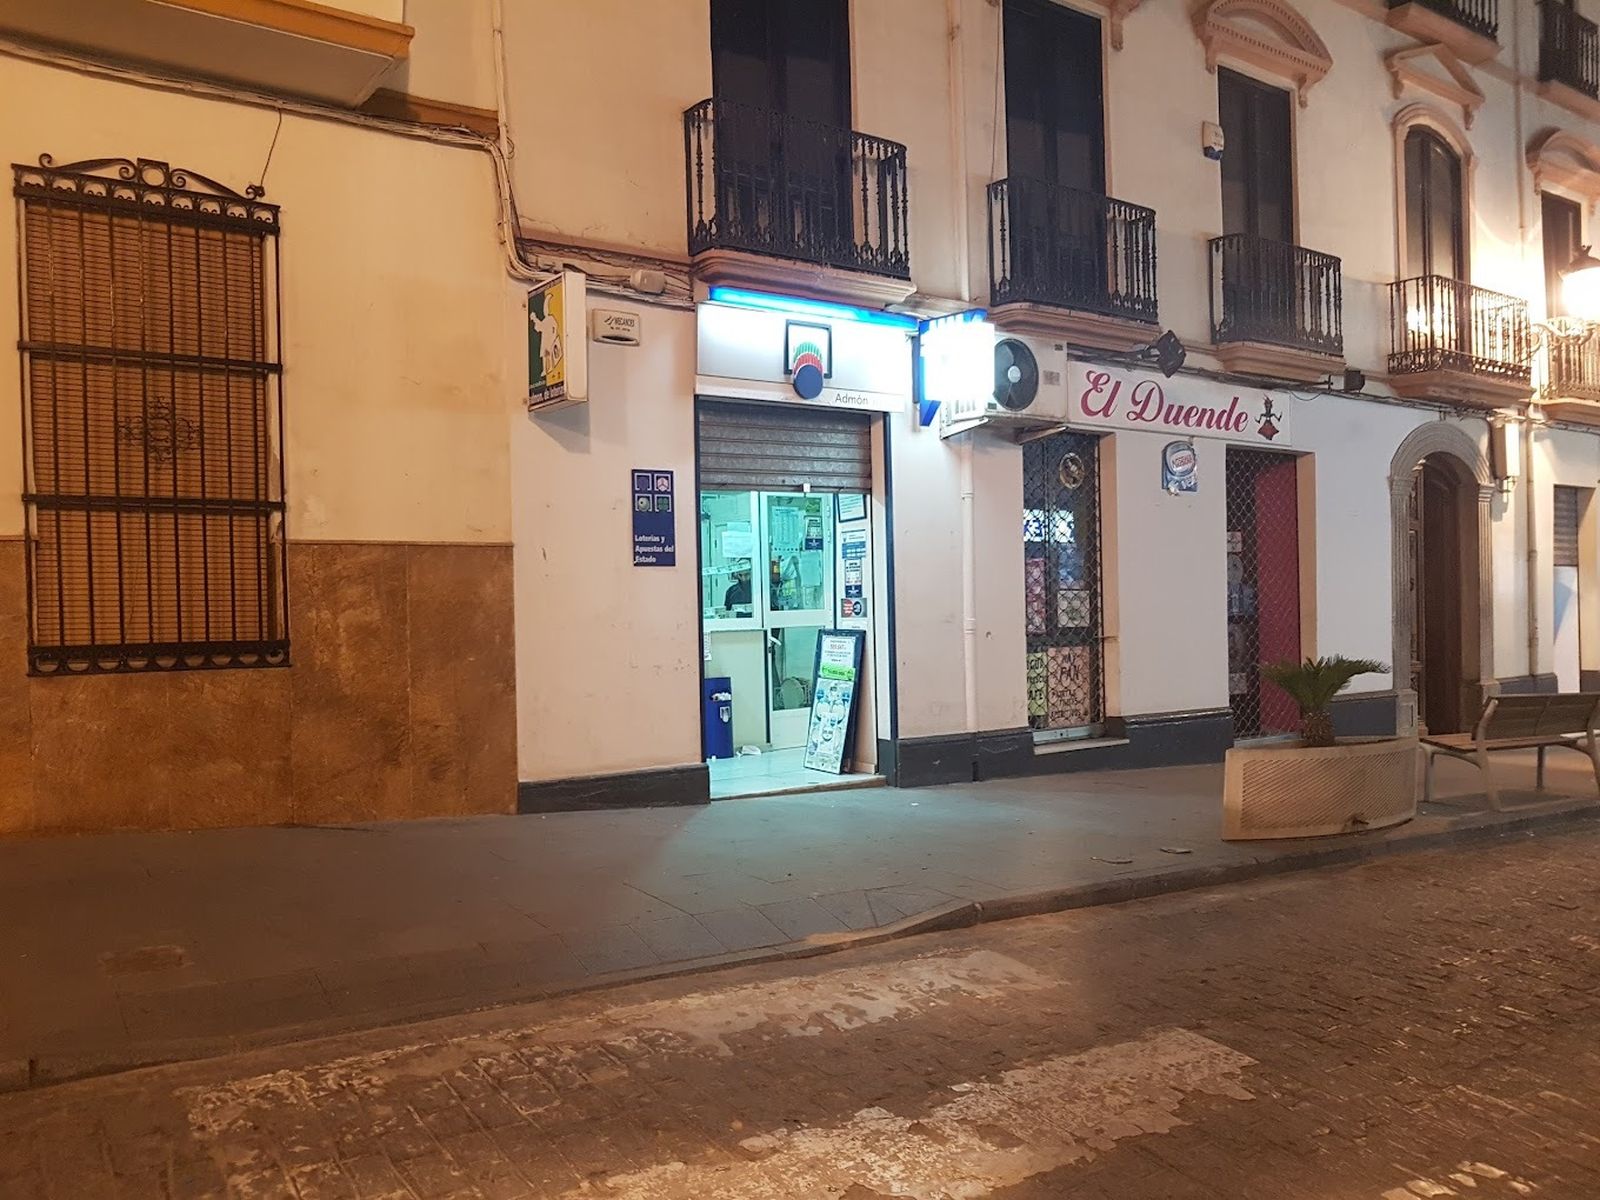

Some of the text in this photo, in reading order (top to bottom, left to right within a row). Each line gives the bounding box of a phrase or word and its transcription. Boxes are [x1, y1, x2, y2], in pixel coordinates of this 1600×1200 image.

[835, 393, 869, 405] Admón
[1080, 369, 1249, 433] El Duende
[635, 545, 663, 553] Apuestas
[635, 555, 656, 563] Estado
